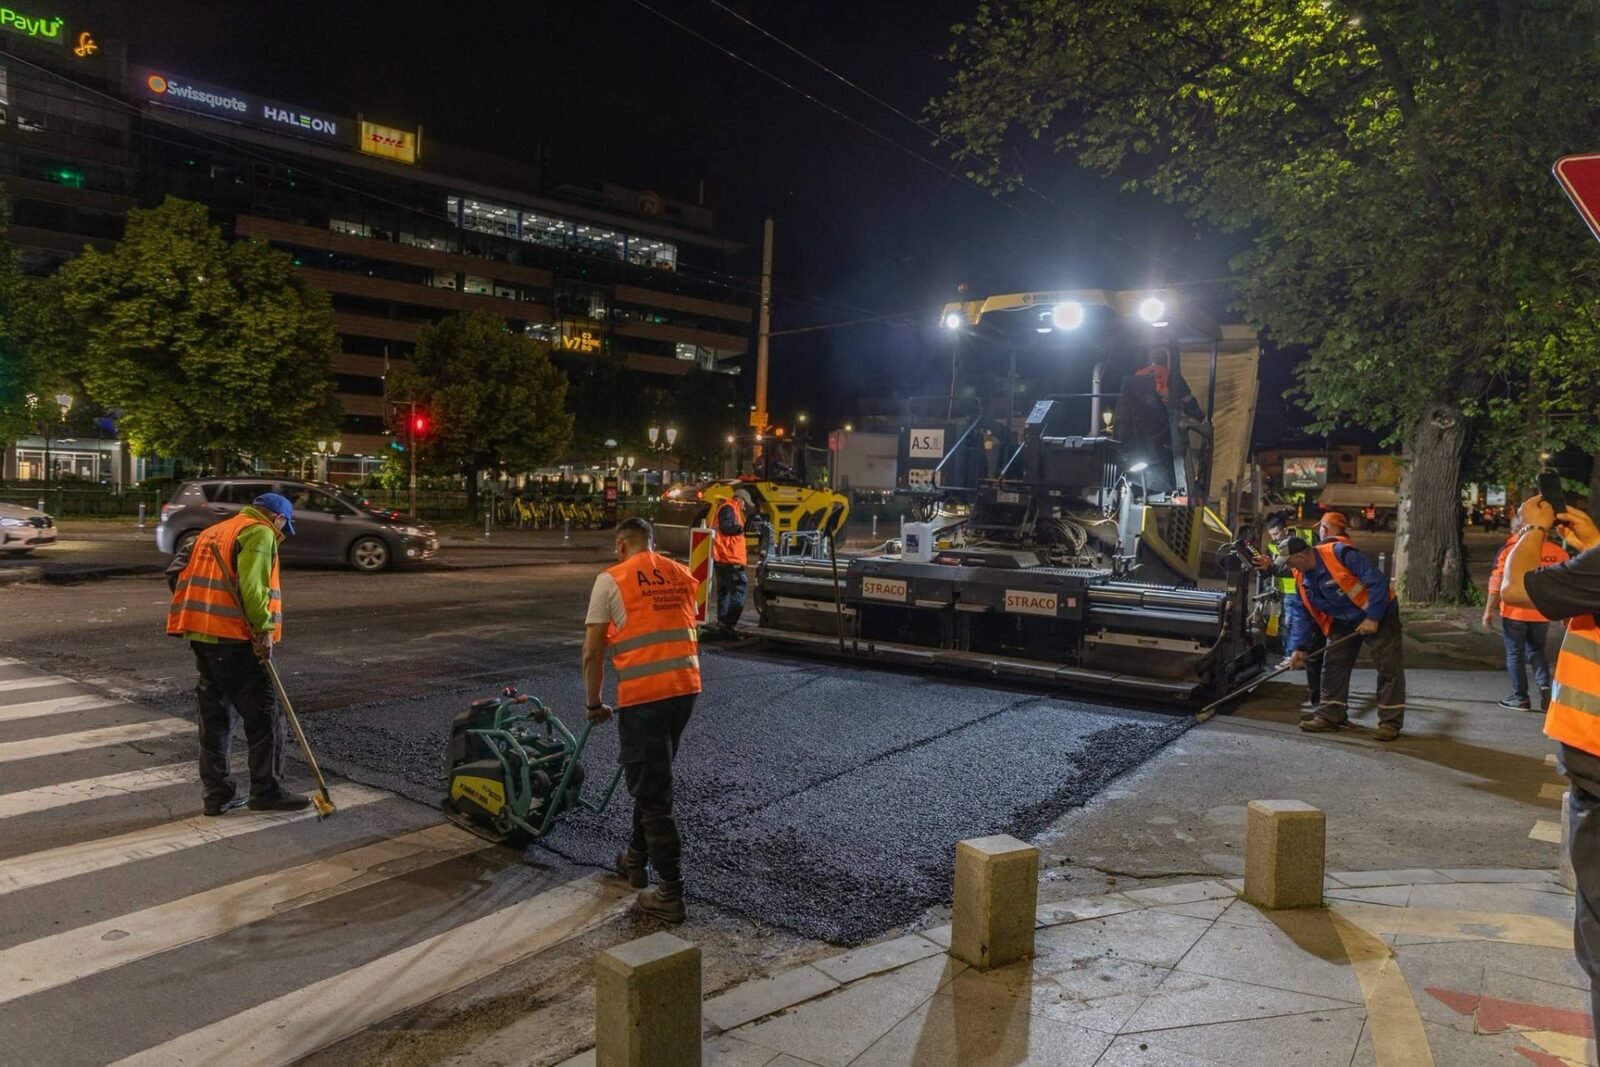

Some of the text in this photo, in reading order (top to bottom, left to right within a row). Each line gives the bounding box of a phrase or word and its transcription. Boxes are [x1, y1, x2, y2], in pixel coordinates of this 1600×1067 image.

[0, 8, 63, 37] PayU
[167, 80, 247, 112] Swissquote
[264, 105, 336, 136] HALEON
[911, 436, 933, 450] A.S.
[637, 569, 671, 586] A.S.
[864, 582, 905, 596] STRACO
[1007, 595, 1056, 609] STRACO
